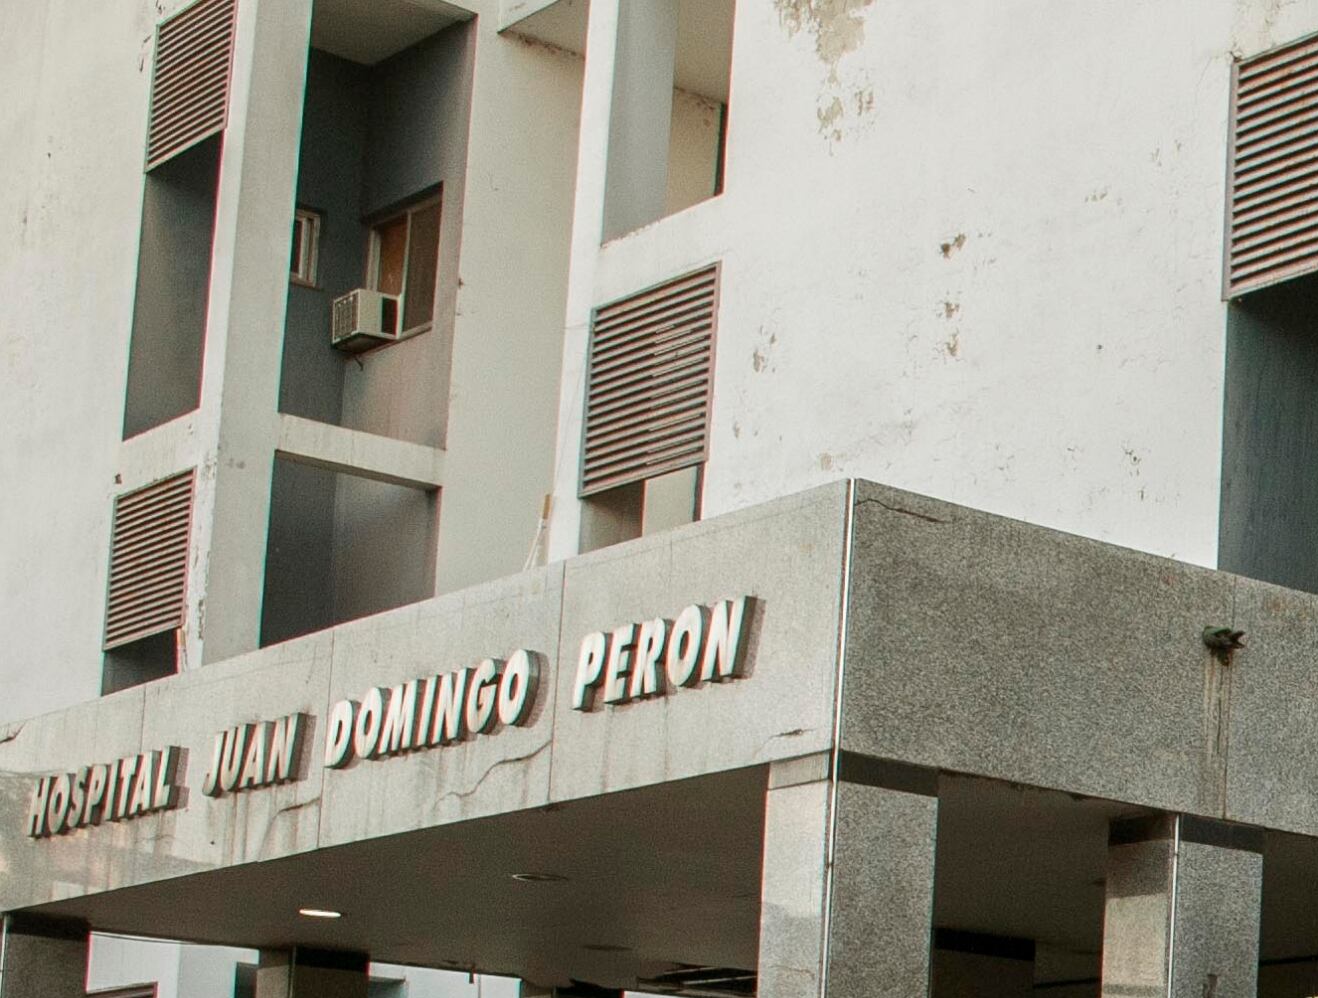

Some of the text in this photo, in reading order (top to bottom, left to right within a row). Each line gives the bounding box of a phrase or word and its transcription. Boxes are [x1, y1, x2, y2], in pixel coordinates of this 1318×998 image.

[28, 595, 759, 838] HOSPITAL JUAN DOMINGO PERON
